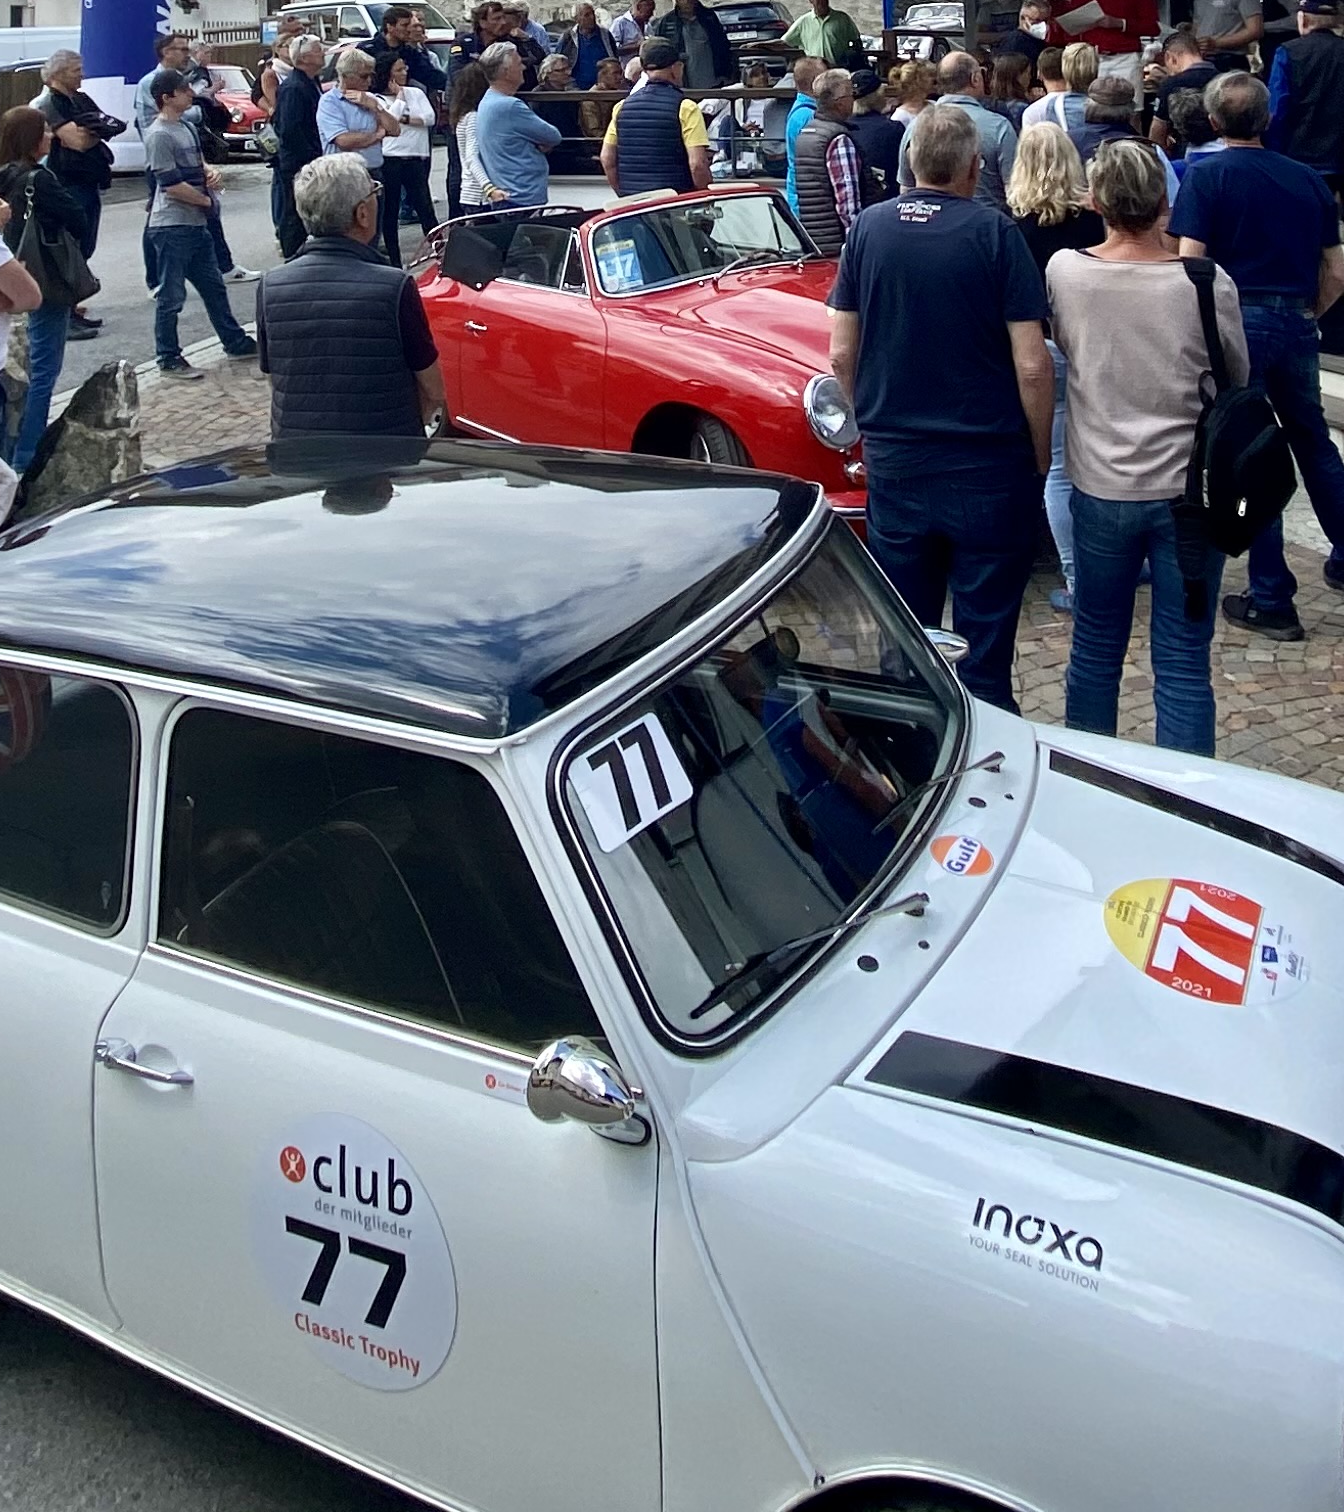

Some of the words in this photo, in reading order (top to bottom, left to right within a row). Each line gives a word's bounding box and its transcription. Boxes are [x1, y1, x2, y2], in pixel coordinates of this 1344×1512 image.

[586, 721, 673, 833] 77
[946, 838, 978, 872] Gulf
[1200, 884, 1237, 902] 2021
[1152, 885, 1255, 986] 77
[1171, 976, 1212, 999] 2021
[312, 1144, 413, 1216] club
[314, 1197, 336, 1217] der
[340, 1207, 413, 1240] mitglieder
[285, 1215, 407, 1329] 77
[968, 1234, 1001, 1255] YOUR
[1004, 1247, 1033, 1267] SEAL
[1038, 1259, 1100, 1292] SOLUTION
[294, 1312, 356, 1351] Classic
[358, 1335, 421, 1377] Trophy
